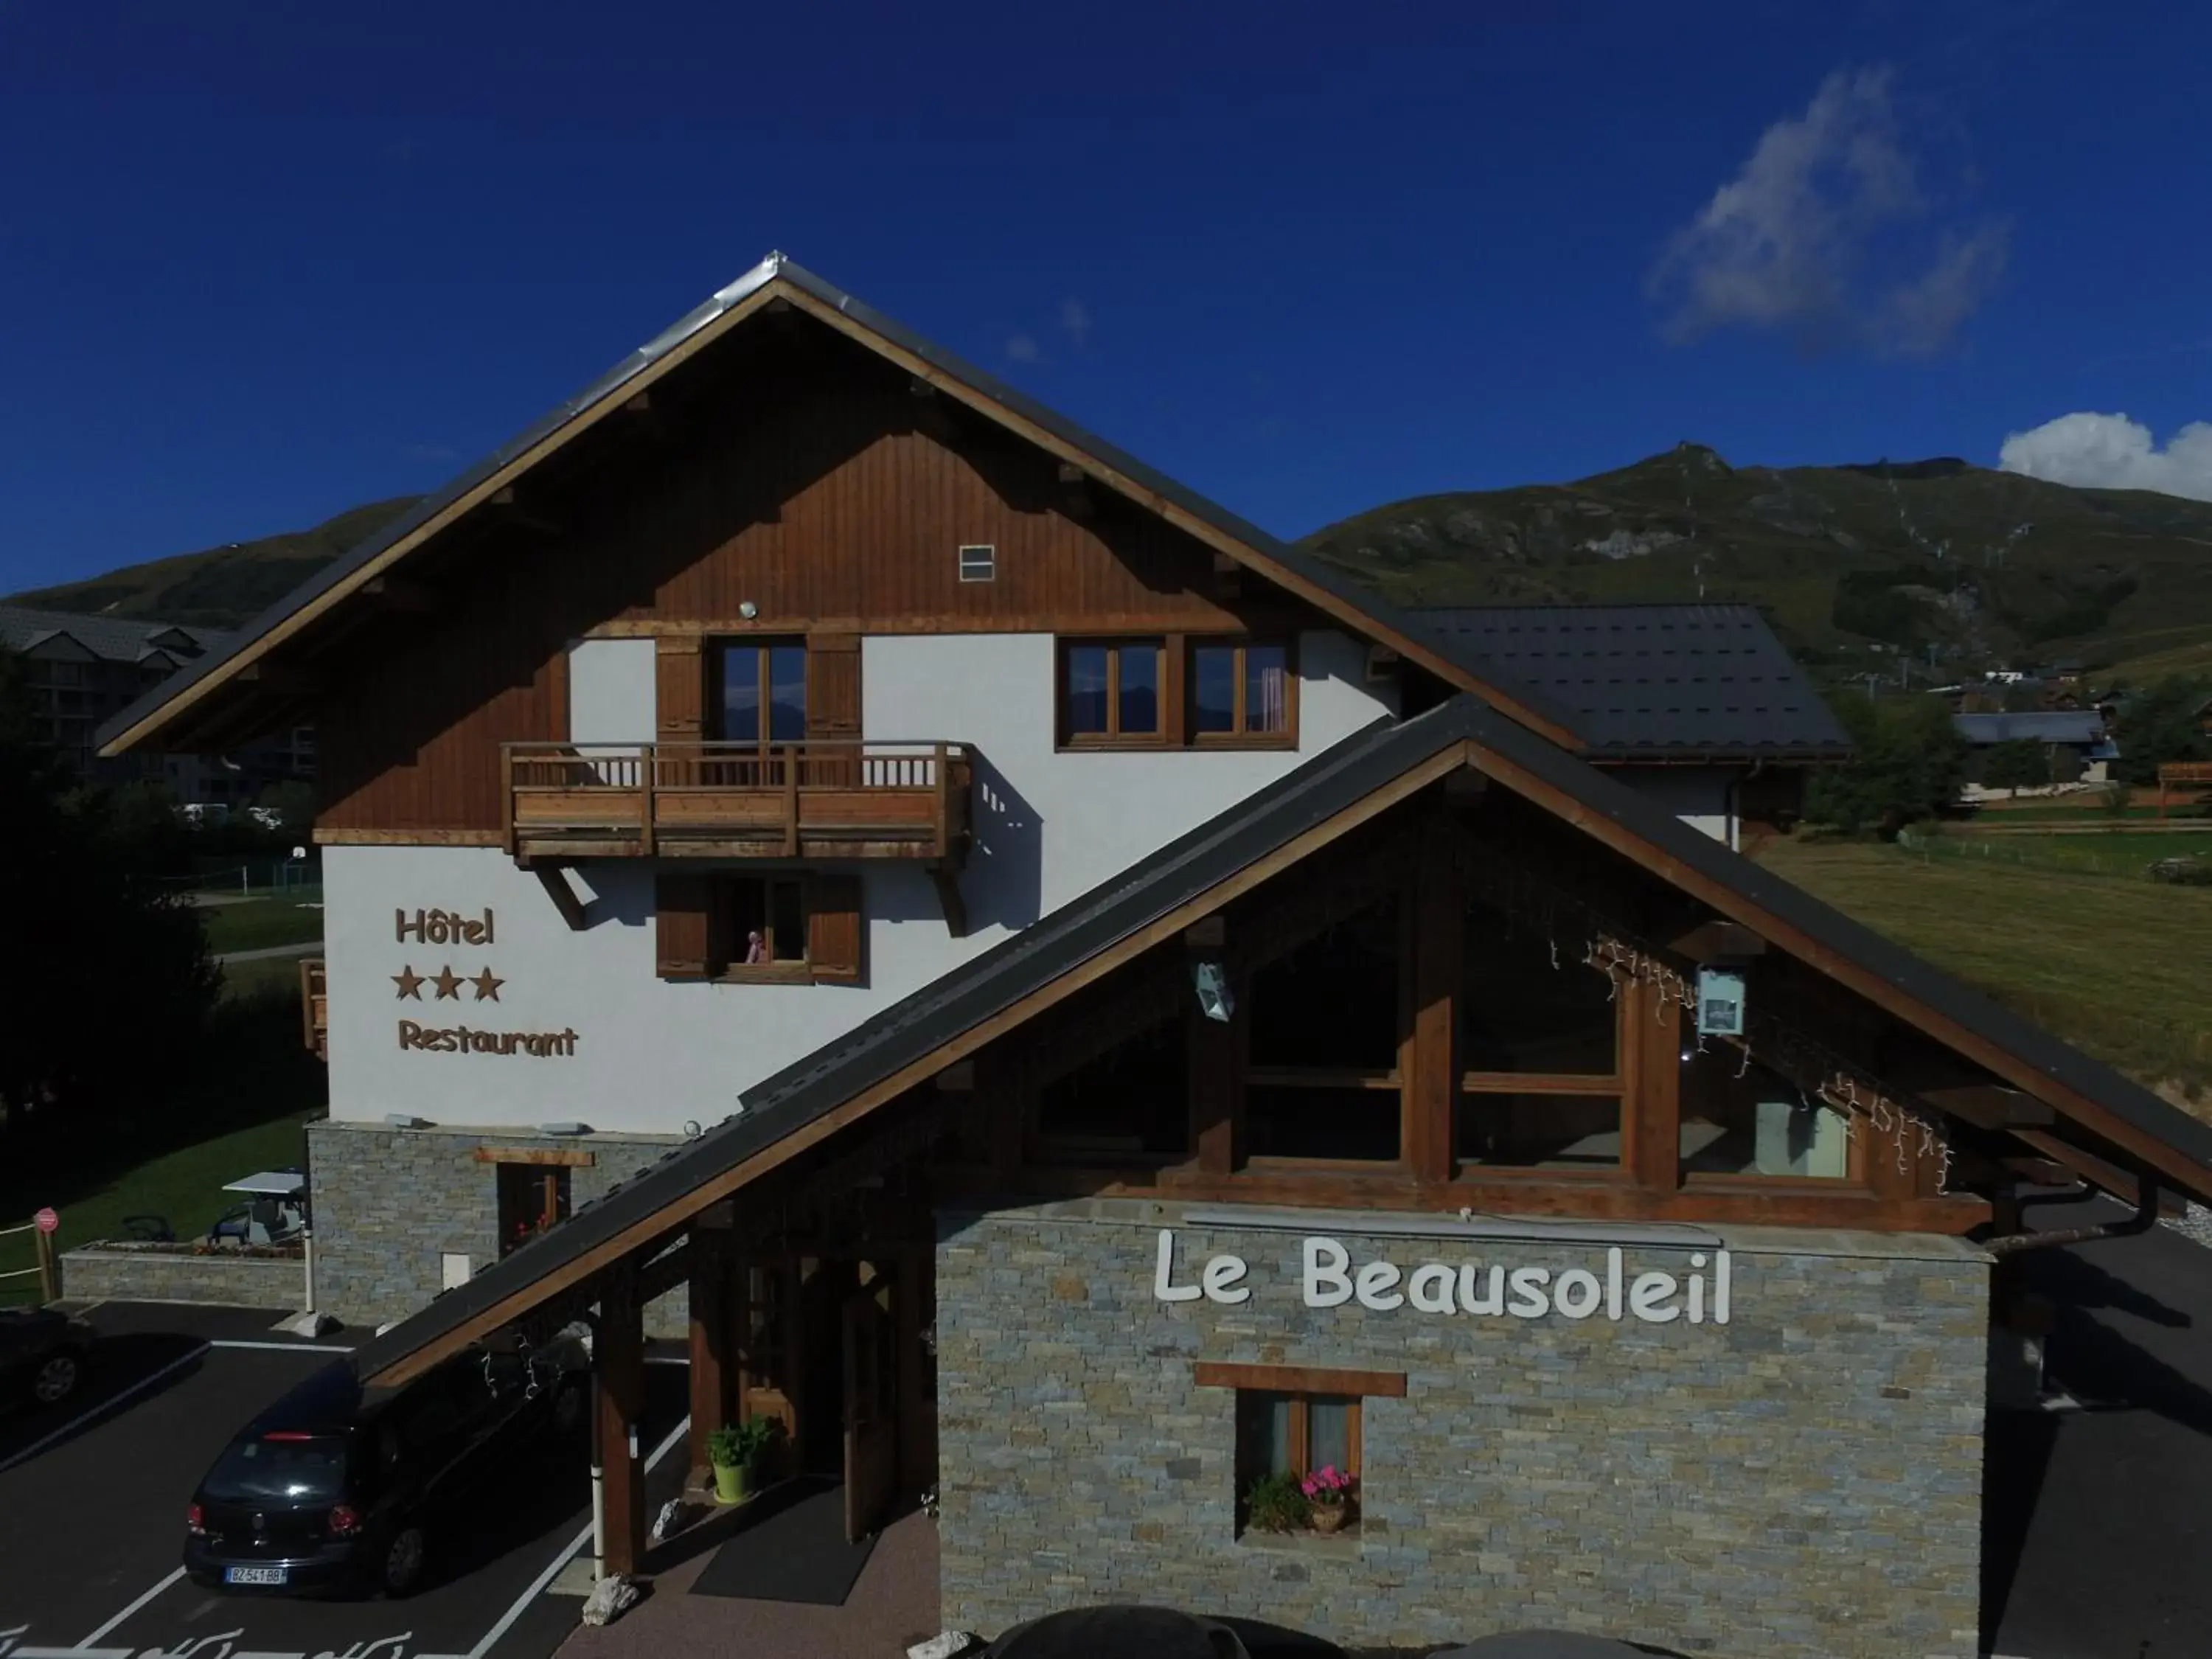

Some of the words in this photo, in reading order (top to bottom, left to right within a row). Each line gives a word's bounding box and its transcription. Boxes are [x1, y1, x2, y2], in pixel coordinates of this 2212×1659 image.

[396, 908, 494, 945] Hôtel
[398, 1020, 579, 1057] Restaurant
[1155, 1229, 1251, 1304] Le
[1303, 1236, 1731, 1324] Beausoleil
